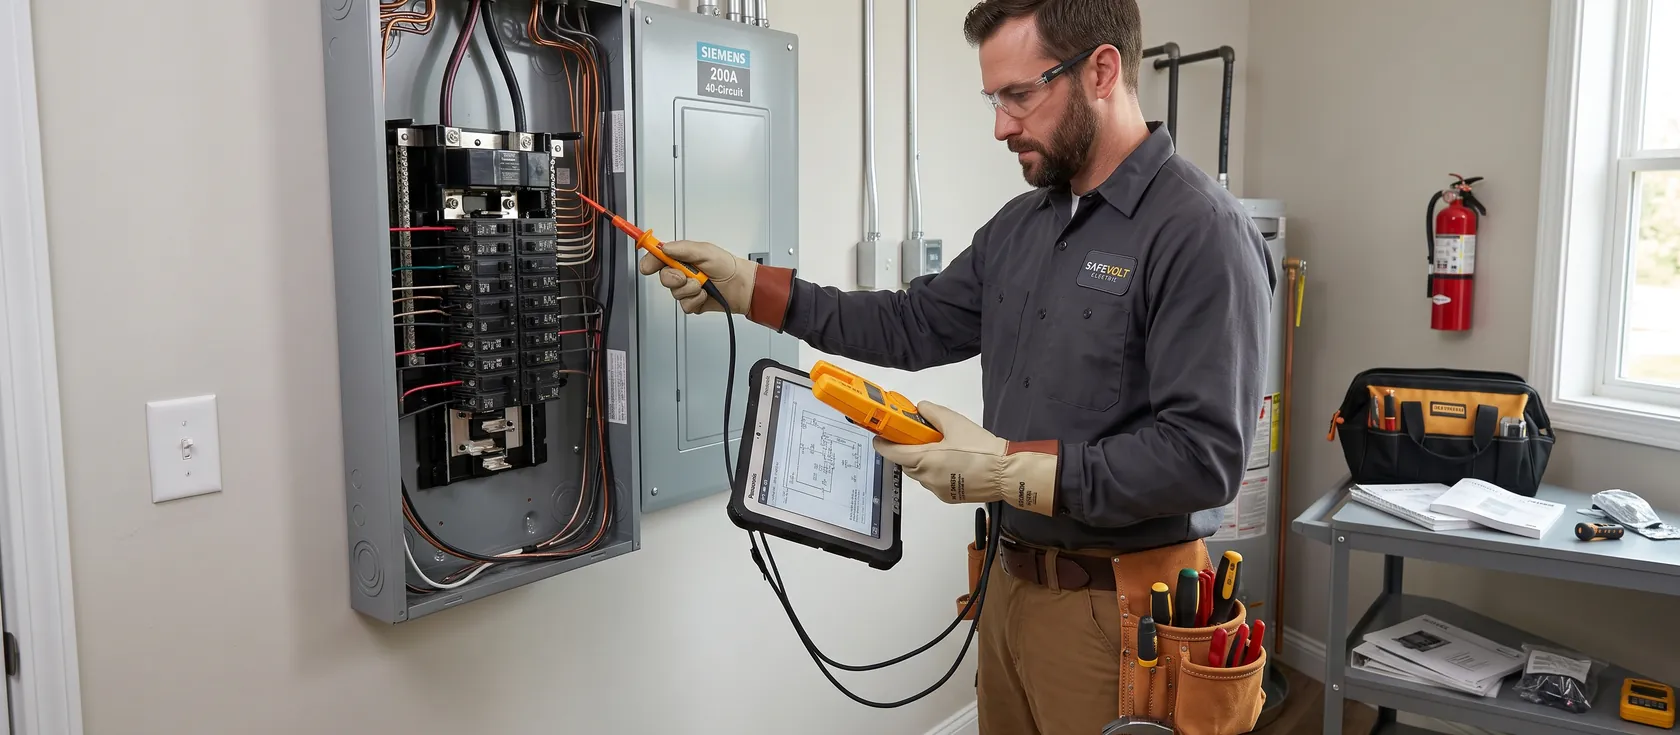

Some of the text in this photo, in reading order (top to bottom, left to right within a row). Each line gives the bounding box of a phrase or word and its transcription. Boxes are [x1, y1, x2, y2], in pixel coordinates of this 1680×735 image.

[701, 46, 746, 64] SIEMENS
[710, 67, 738, 84] 200A
[705, 83, 744, 97] 40-Circuit
[1085, 261, 1130, 278] SAFEVOLT
